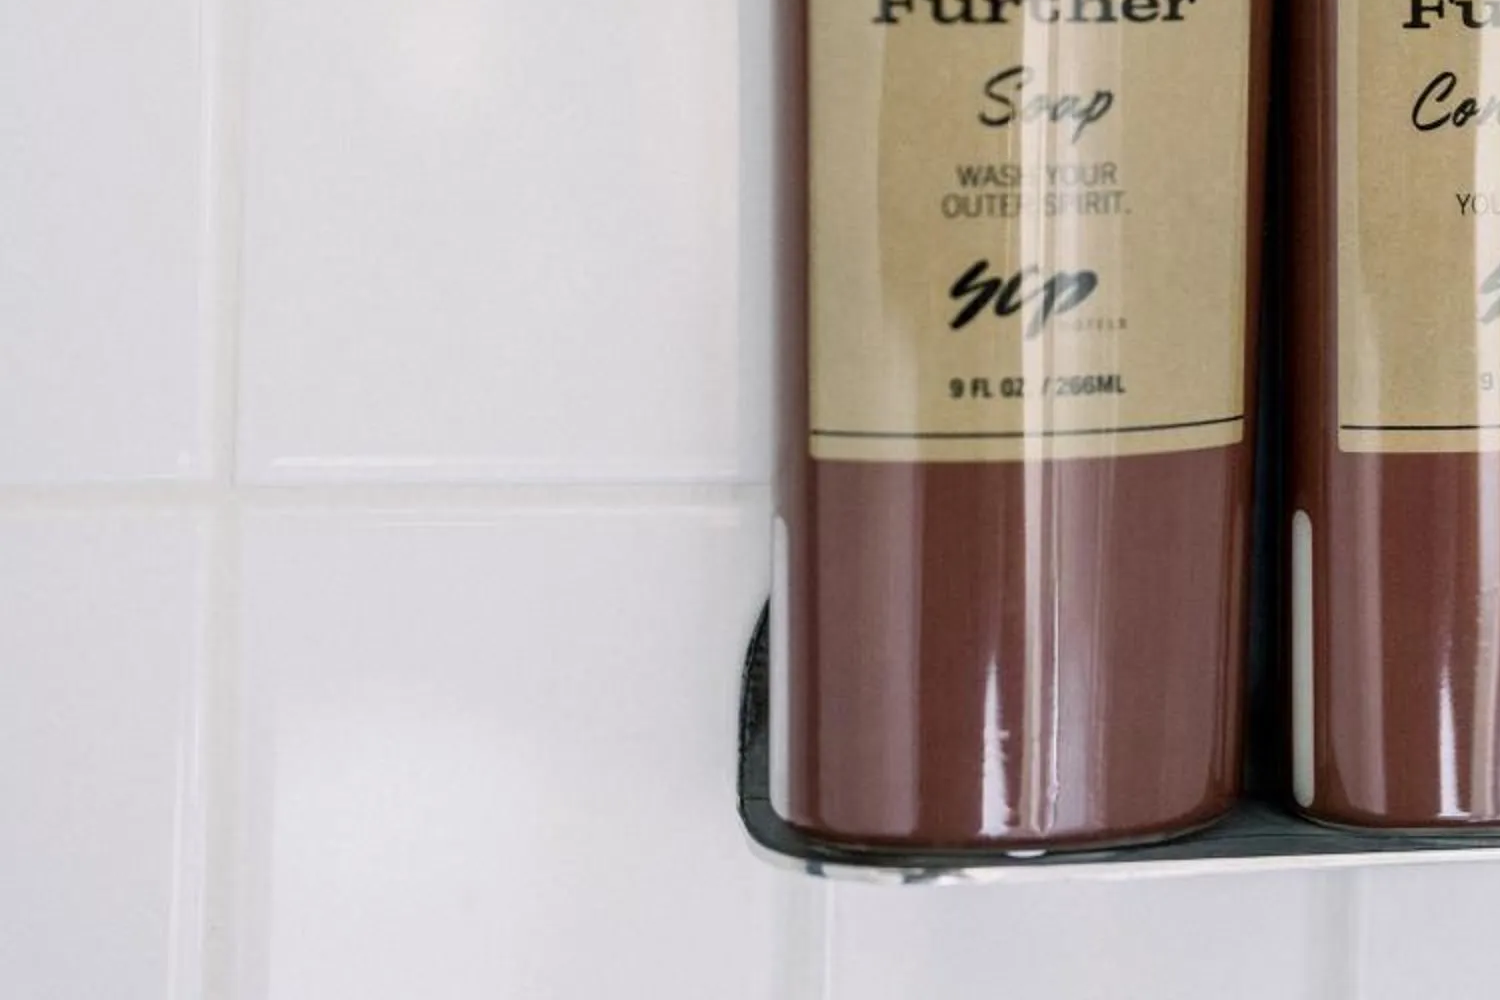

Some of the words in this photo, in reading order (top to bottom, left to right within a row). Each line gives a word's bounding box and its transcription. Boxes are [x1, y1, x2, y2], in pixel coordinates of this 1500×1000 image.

[978, 65, 1115, 144] Soap
[1046, 161, 1118, 186] YOUR
[949, 377, 965, 399] 9
[970, 377, 993, 398] FL
[1056, 375, 1126, 396] 266ML
[1481, 371, 1494, 390] 9
